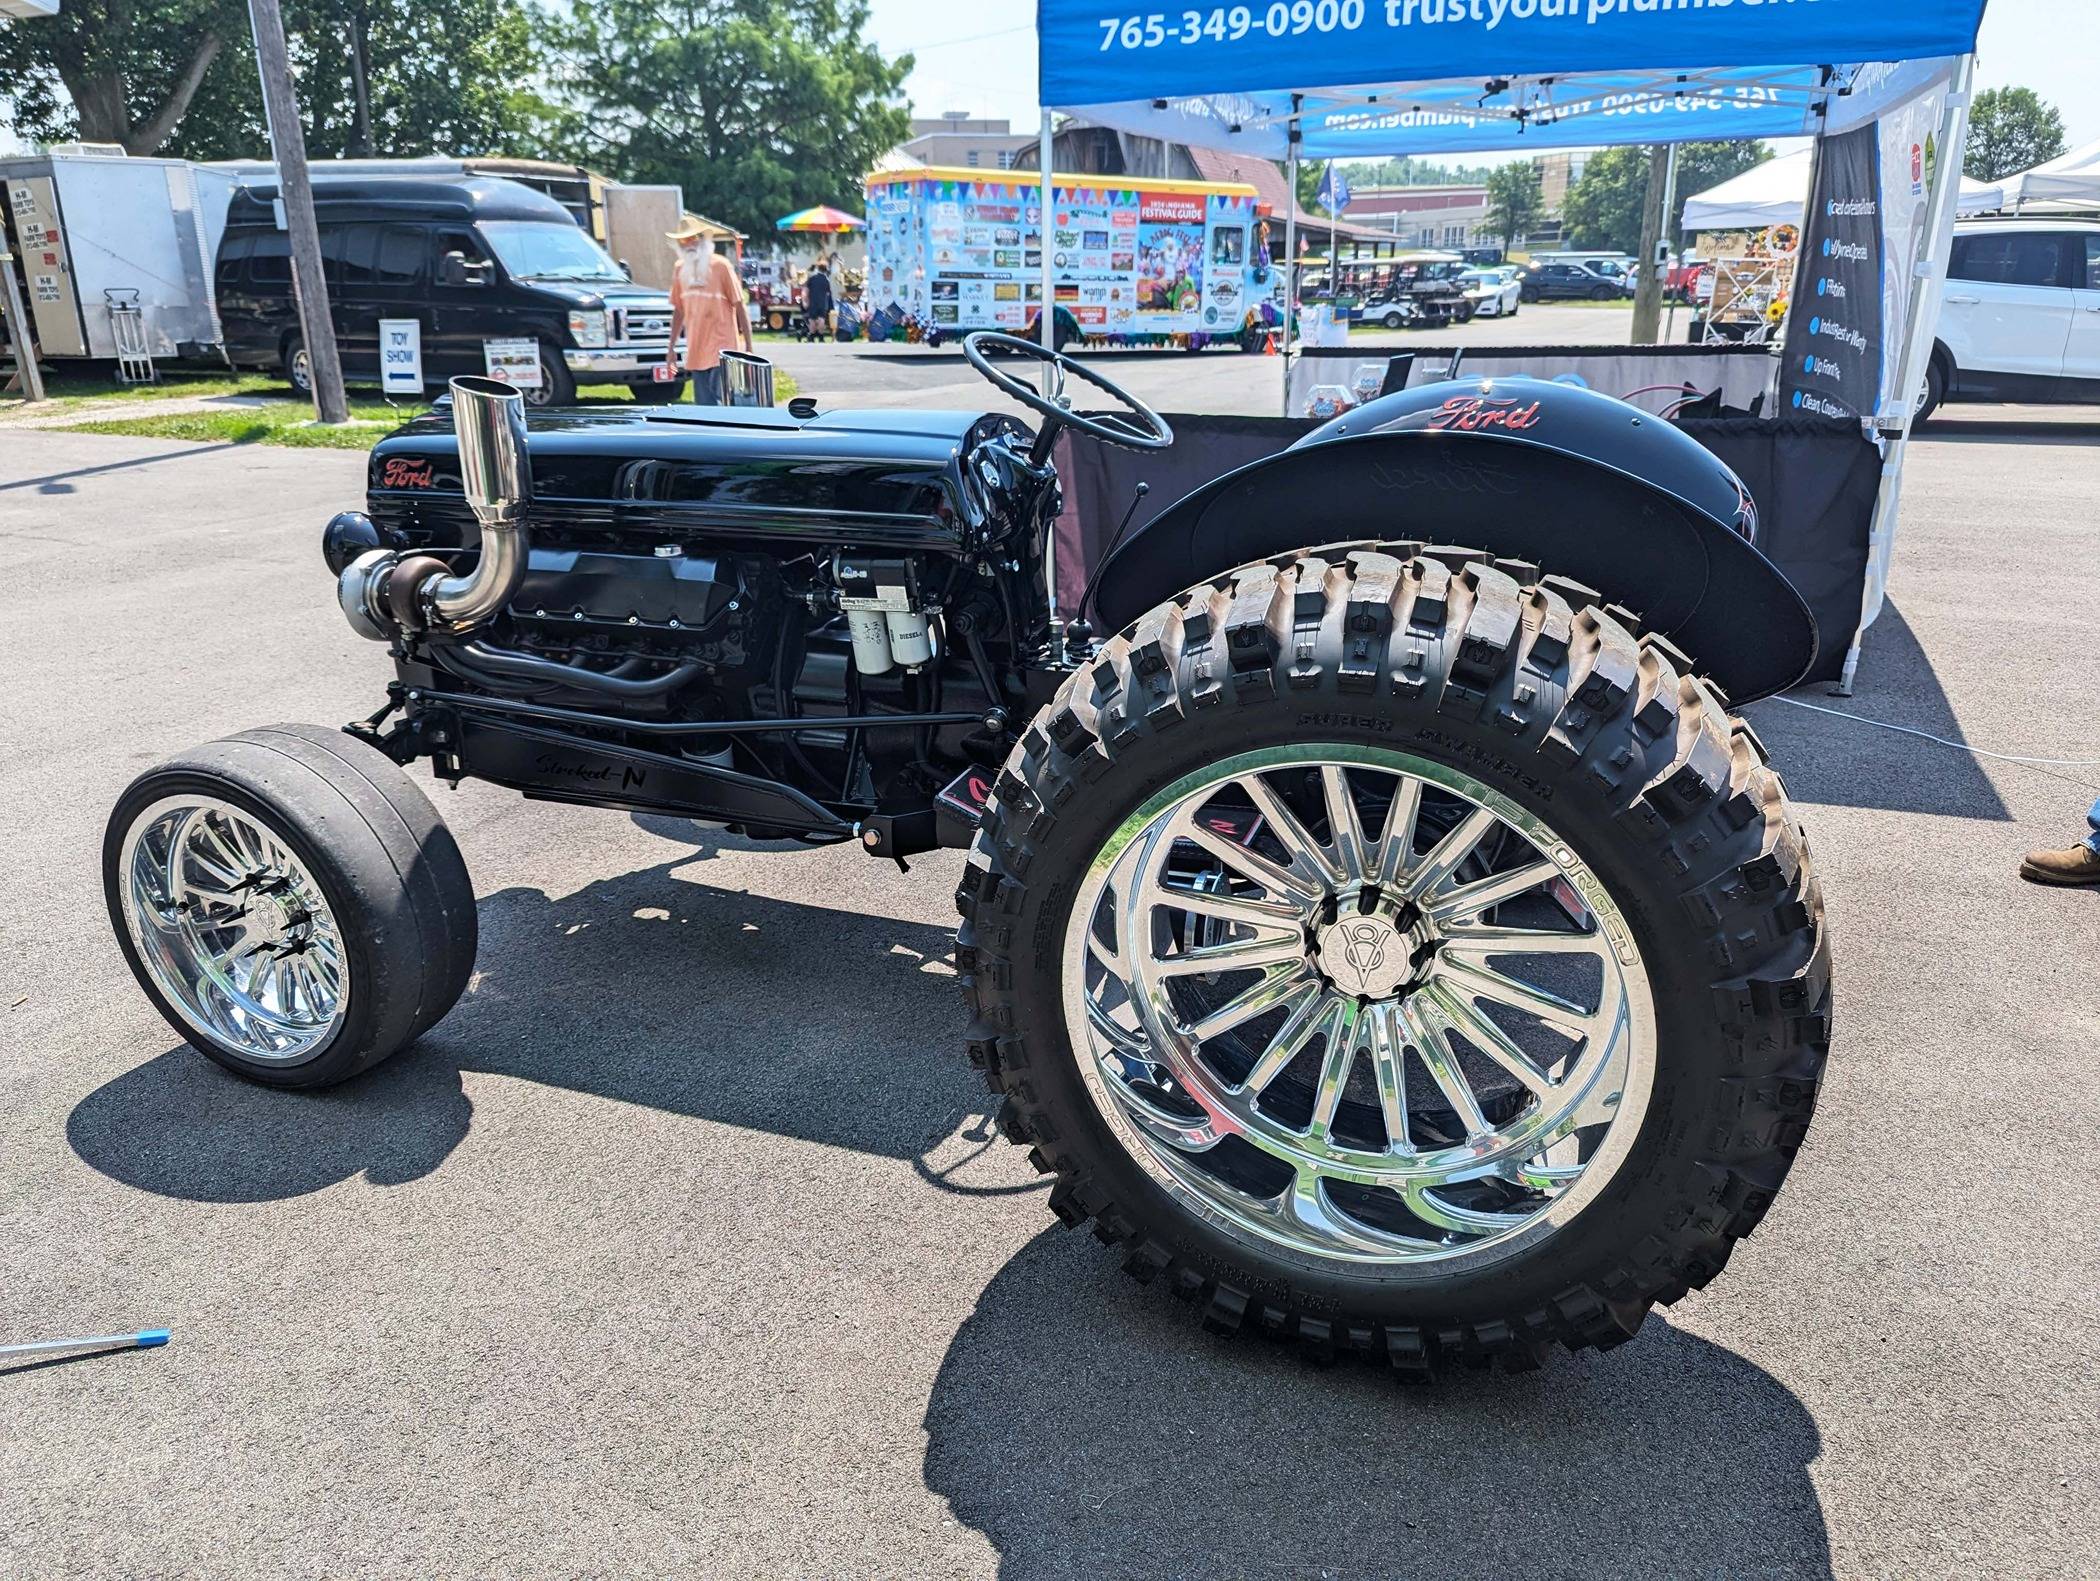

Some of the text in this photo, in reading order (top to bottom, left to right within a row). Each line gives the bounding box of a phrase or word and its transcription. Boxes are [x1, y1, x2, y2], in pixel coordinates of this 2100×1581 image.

[1099, 0, 1365, 51] 765-349-0900
[1141, 206, 1203, 220] FESTIVAL GUIDE
[390, 332, 409, 346] TOY
[386, 350, 415, 364] SHOW
[1427, 395, 1541, 430] Ford
[384, 457, 432, 487] Ford
[899, 631, 919, 640] DIESEL
[1296, 712, 1554, 802] SUPER SWAMPER
[1527, 820, 1641, 967] FORGED
[1084, 1071, 1174, 1191] FORGED
